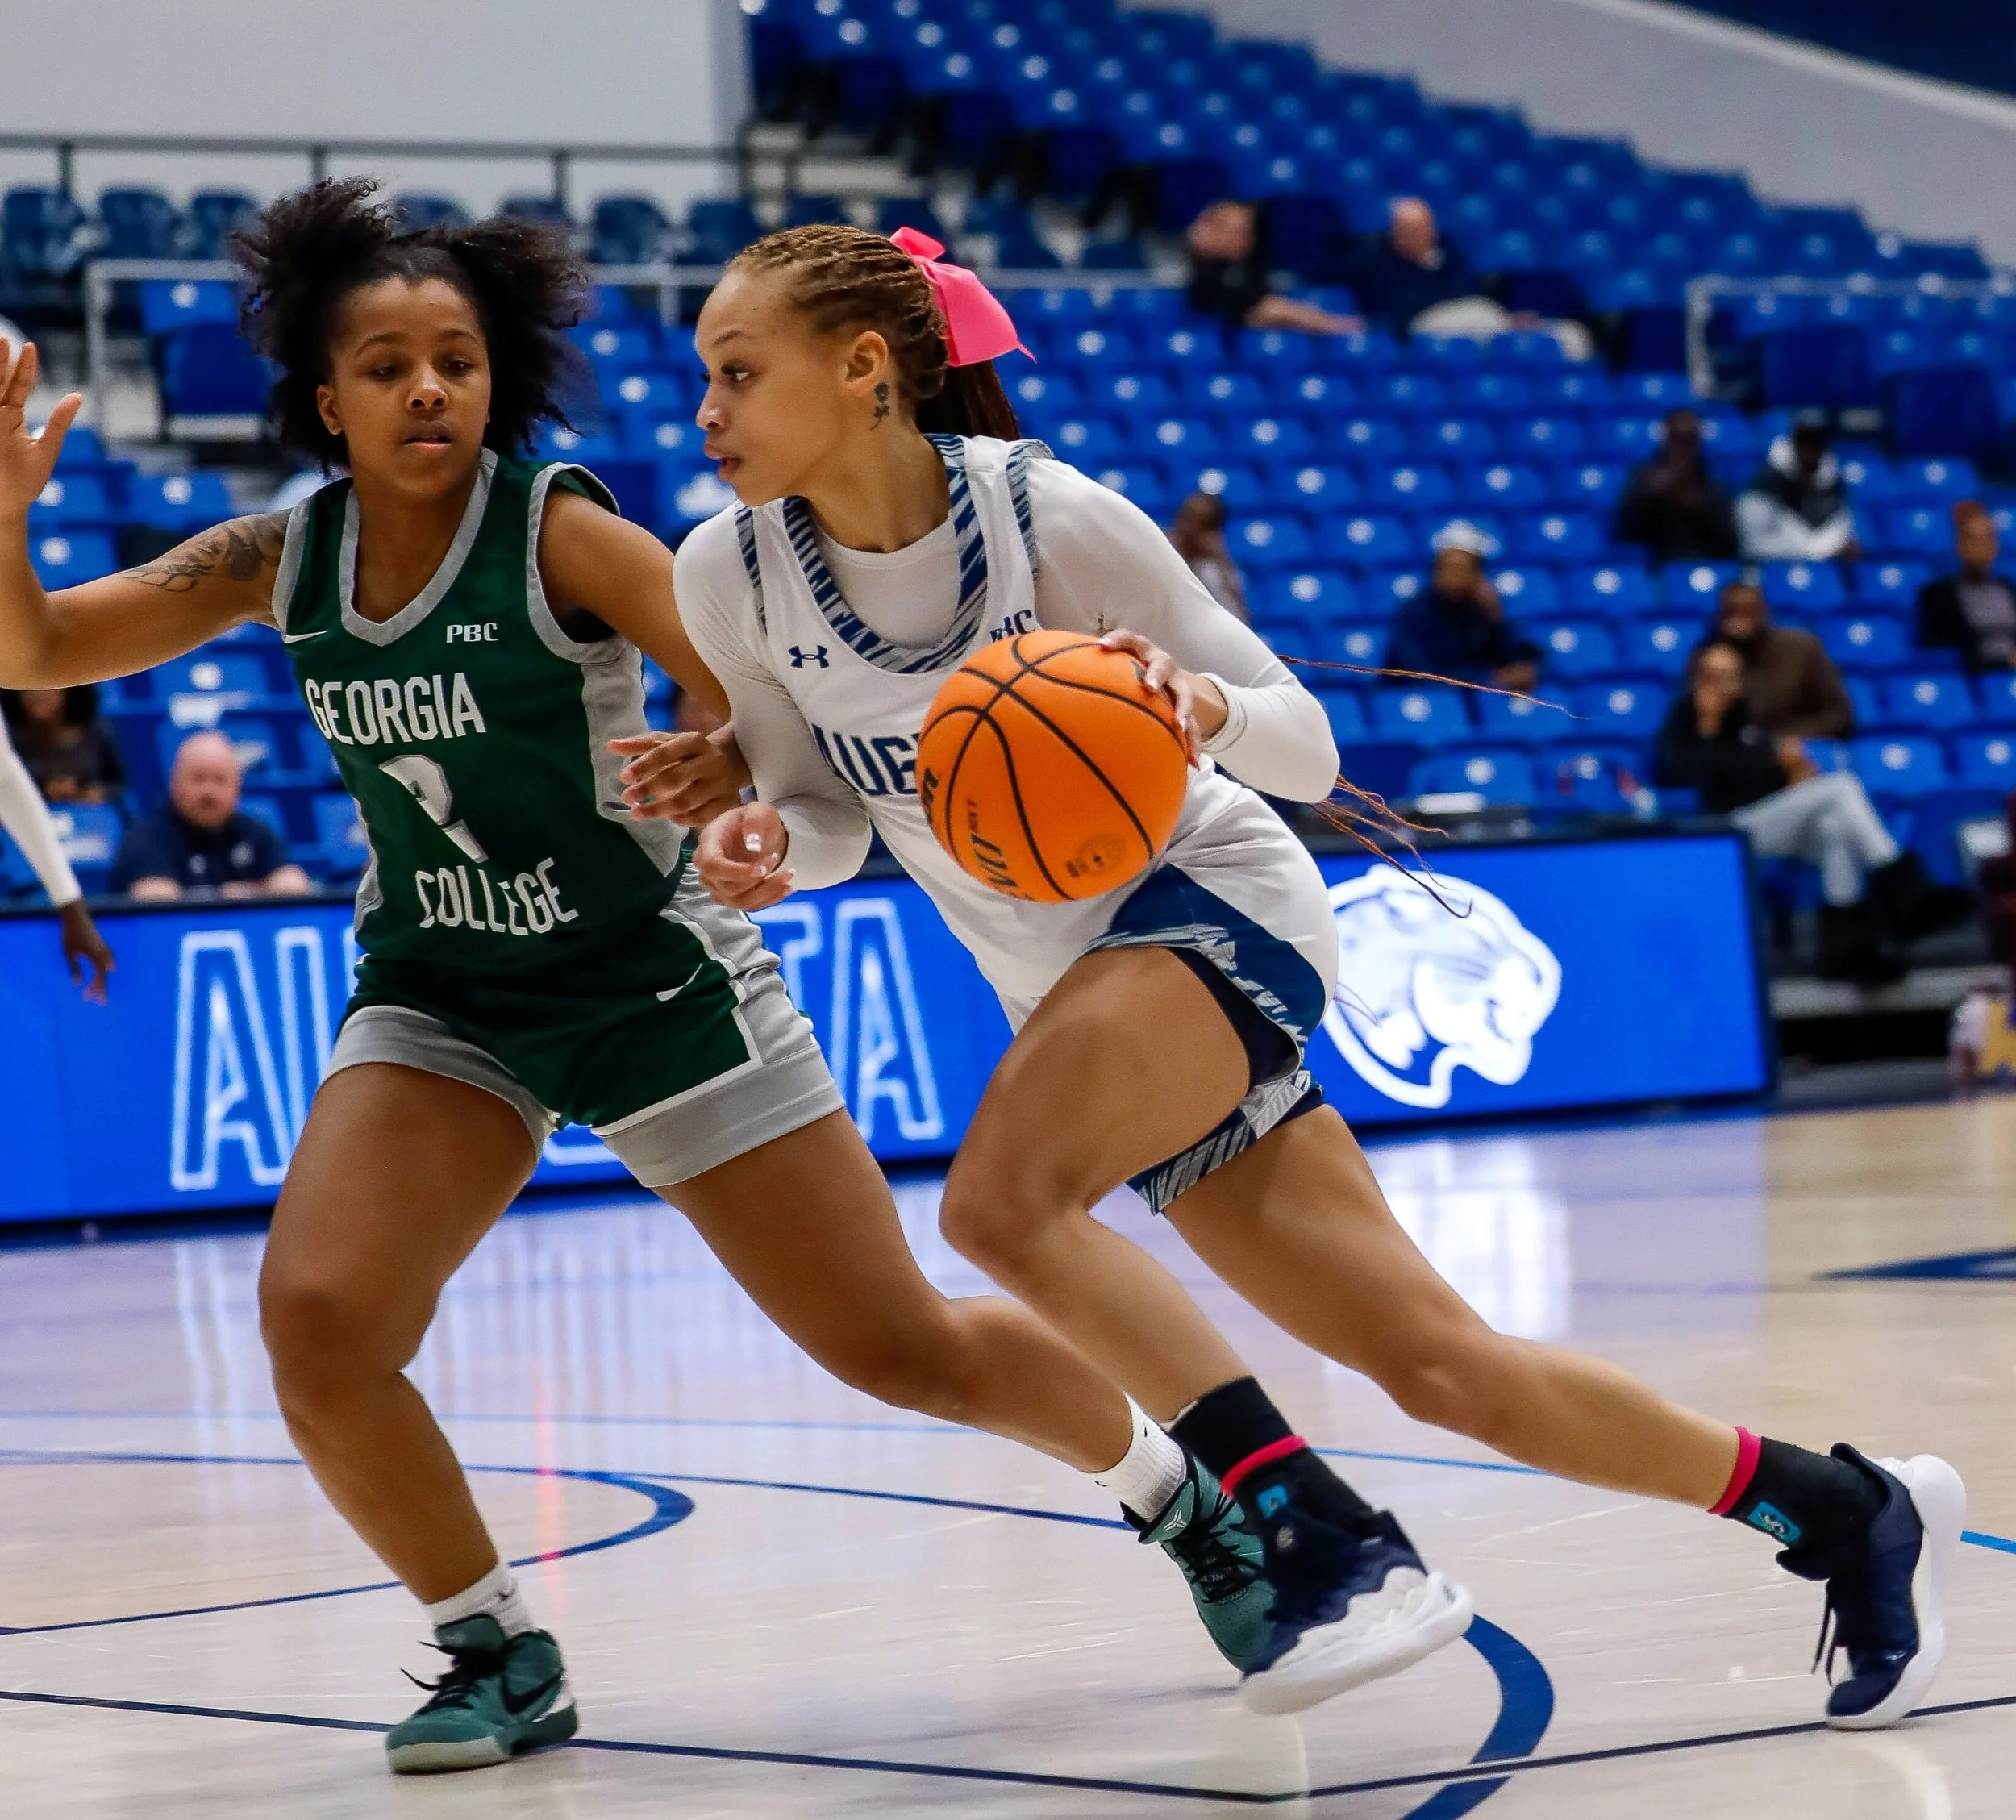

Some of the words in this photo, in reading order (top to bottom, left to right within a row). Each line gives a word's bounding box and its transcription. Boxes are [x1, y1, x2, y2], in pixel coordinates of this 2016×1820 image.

[446, 623, 499, 643] PBC
[305, 673, 486, 744] GEORGIA
[415, 856, 579, 935] COLLEGE
